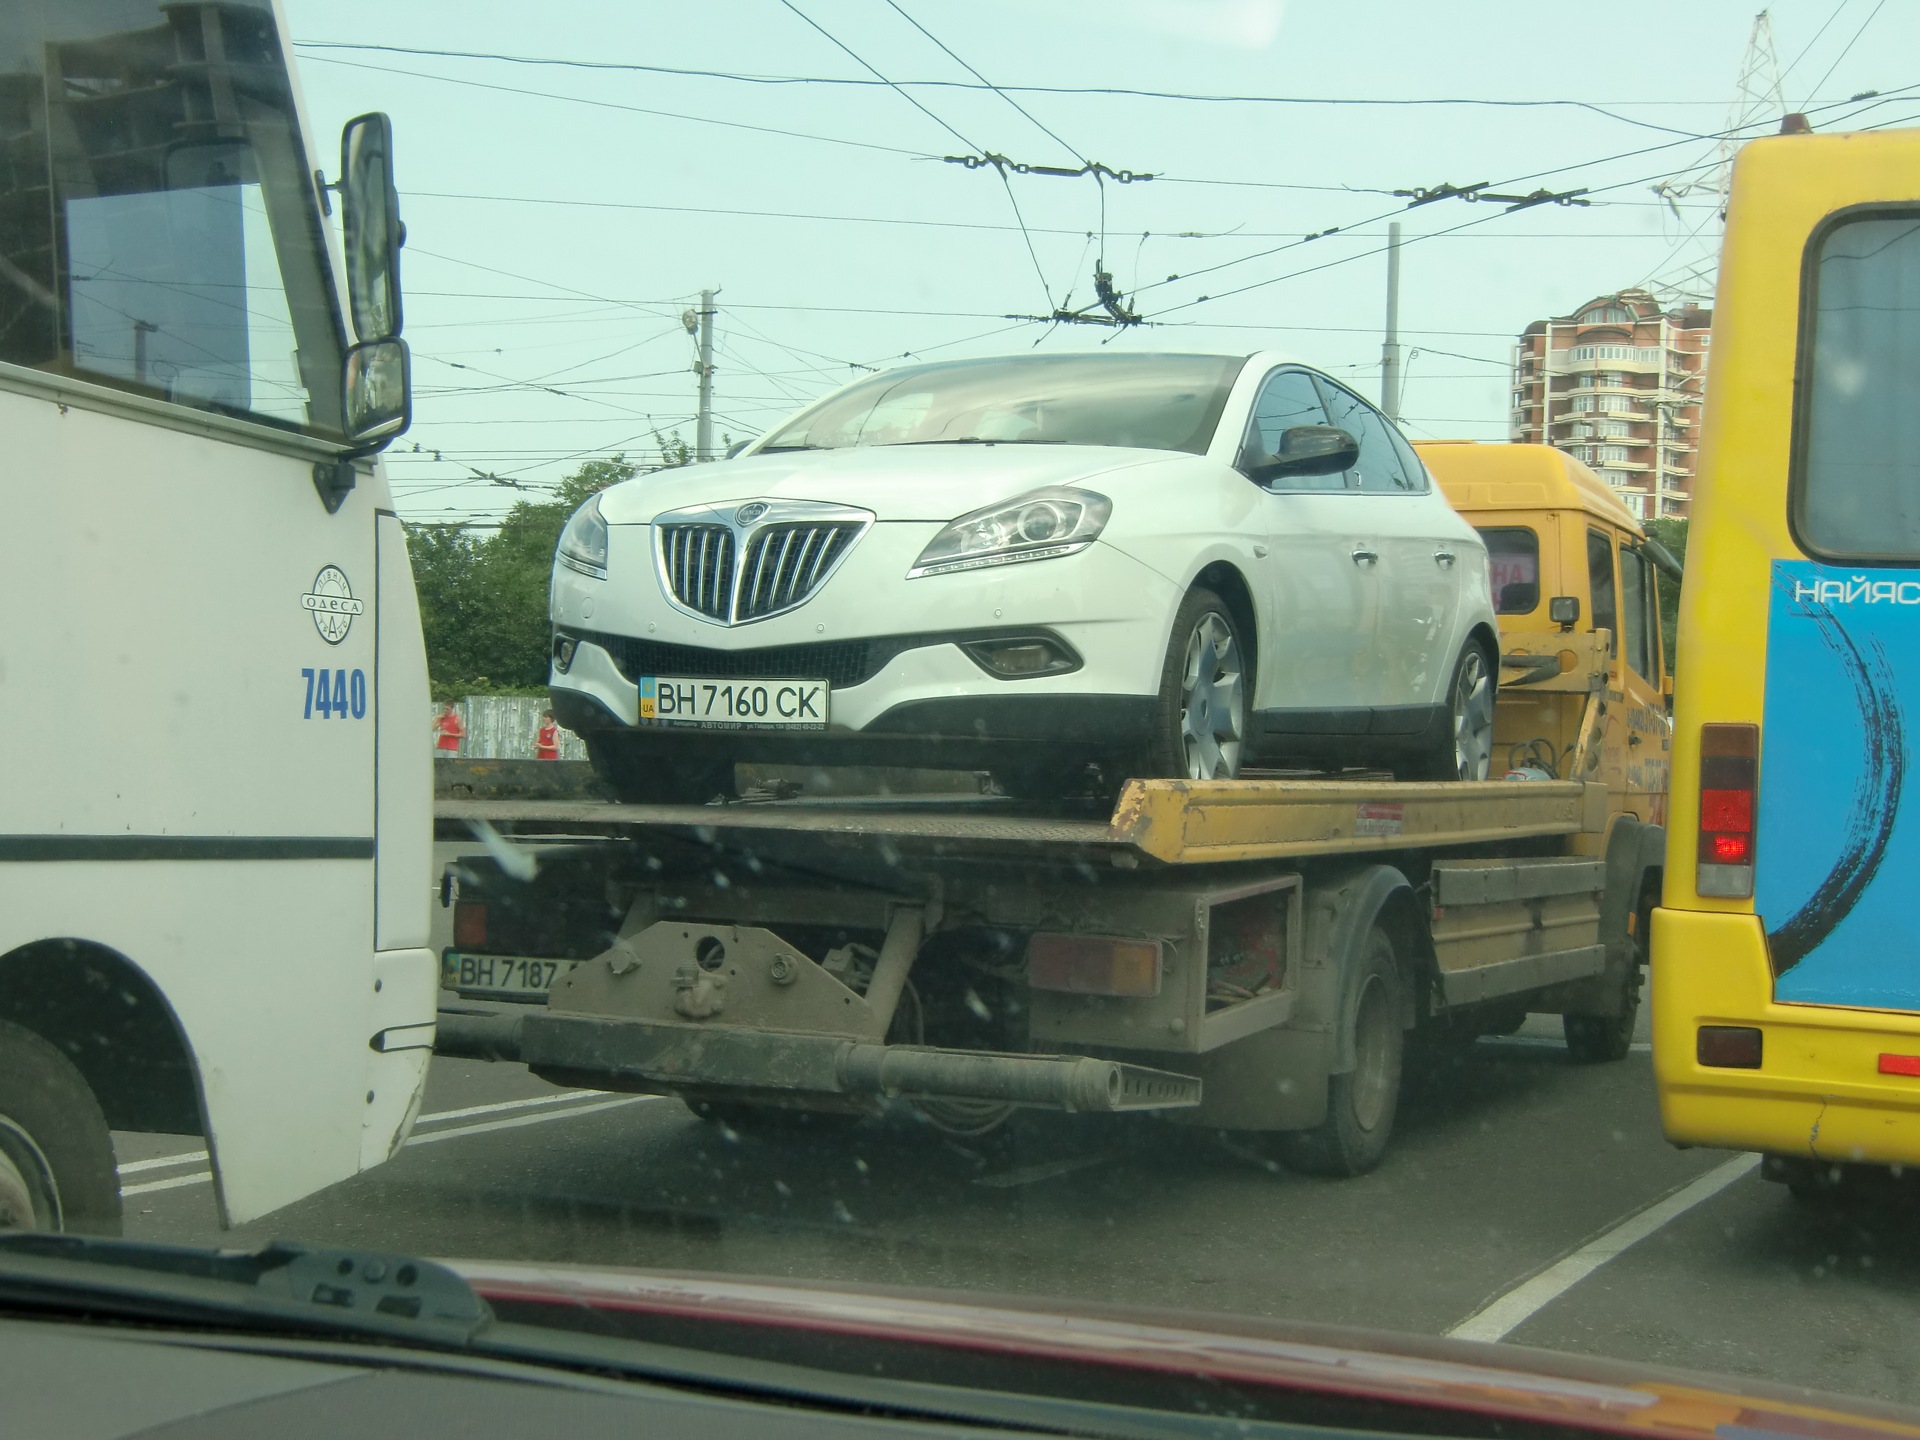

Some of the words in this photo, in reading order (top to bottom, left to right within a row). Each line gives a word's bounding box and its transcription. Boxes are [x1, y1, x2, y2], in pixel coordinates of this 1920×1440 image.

[301, 668, 366, 719] 7440
[643, 704, 654, 713] UA
[658, 683, 696, 715] BH
[702, 685, 768, 716] 7160
[776, 687, 820, 718] CK
[460, 958, 494, 985] BH
[501, 960, 557, 989] 7187
